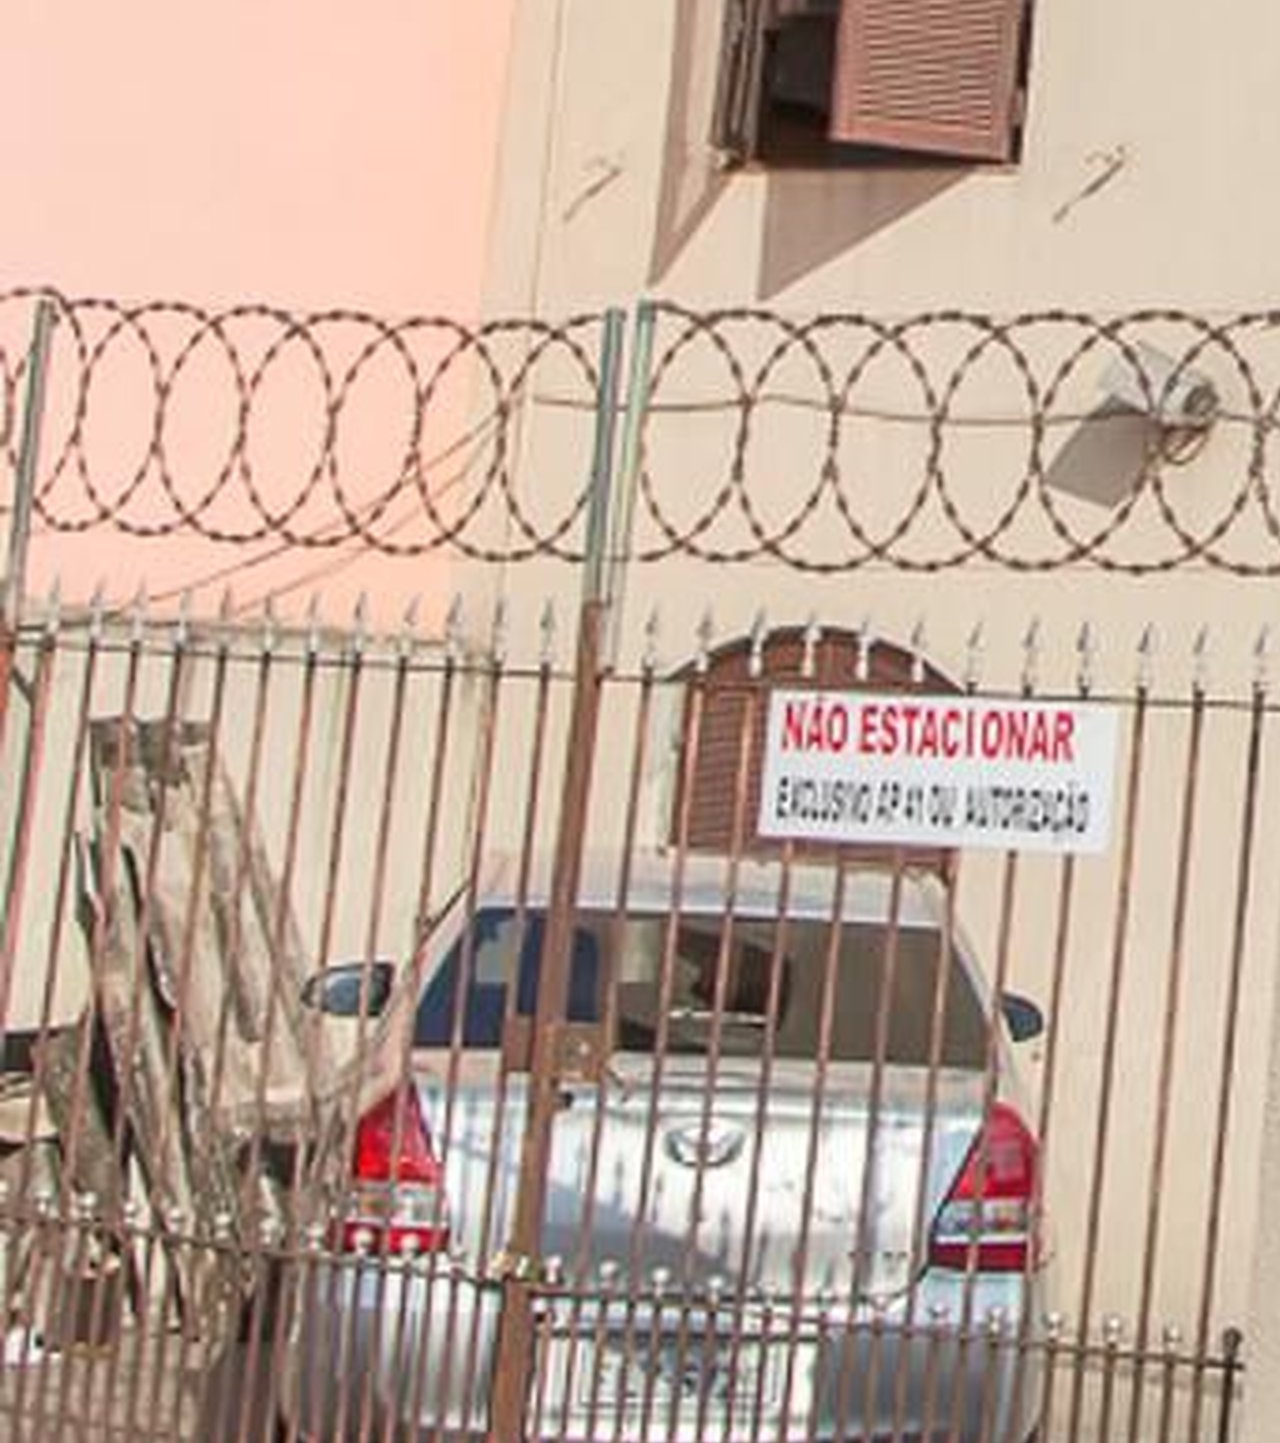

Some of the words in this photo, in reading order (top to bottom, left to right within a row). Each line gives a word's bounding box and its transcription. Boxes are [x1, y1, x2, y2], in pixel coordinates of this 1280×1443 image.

[780, 696, 849, 755] NÃO
[857, 704, 1076, 763] ESTACIONAR
[775, 775, 872, 825] EXCLUSIVO
[929, 783, 958, 829] OU
[965, 781, 1090, 839] AUTORIZAÇÃO
